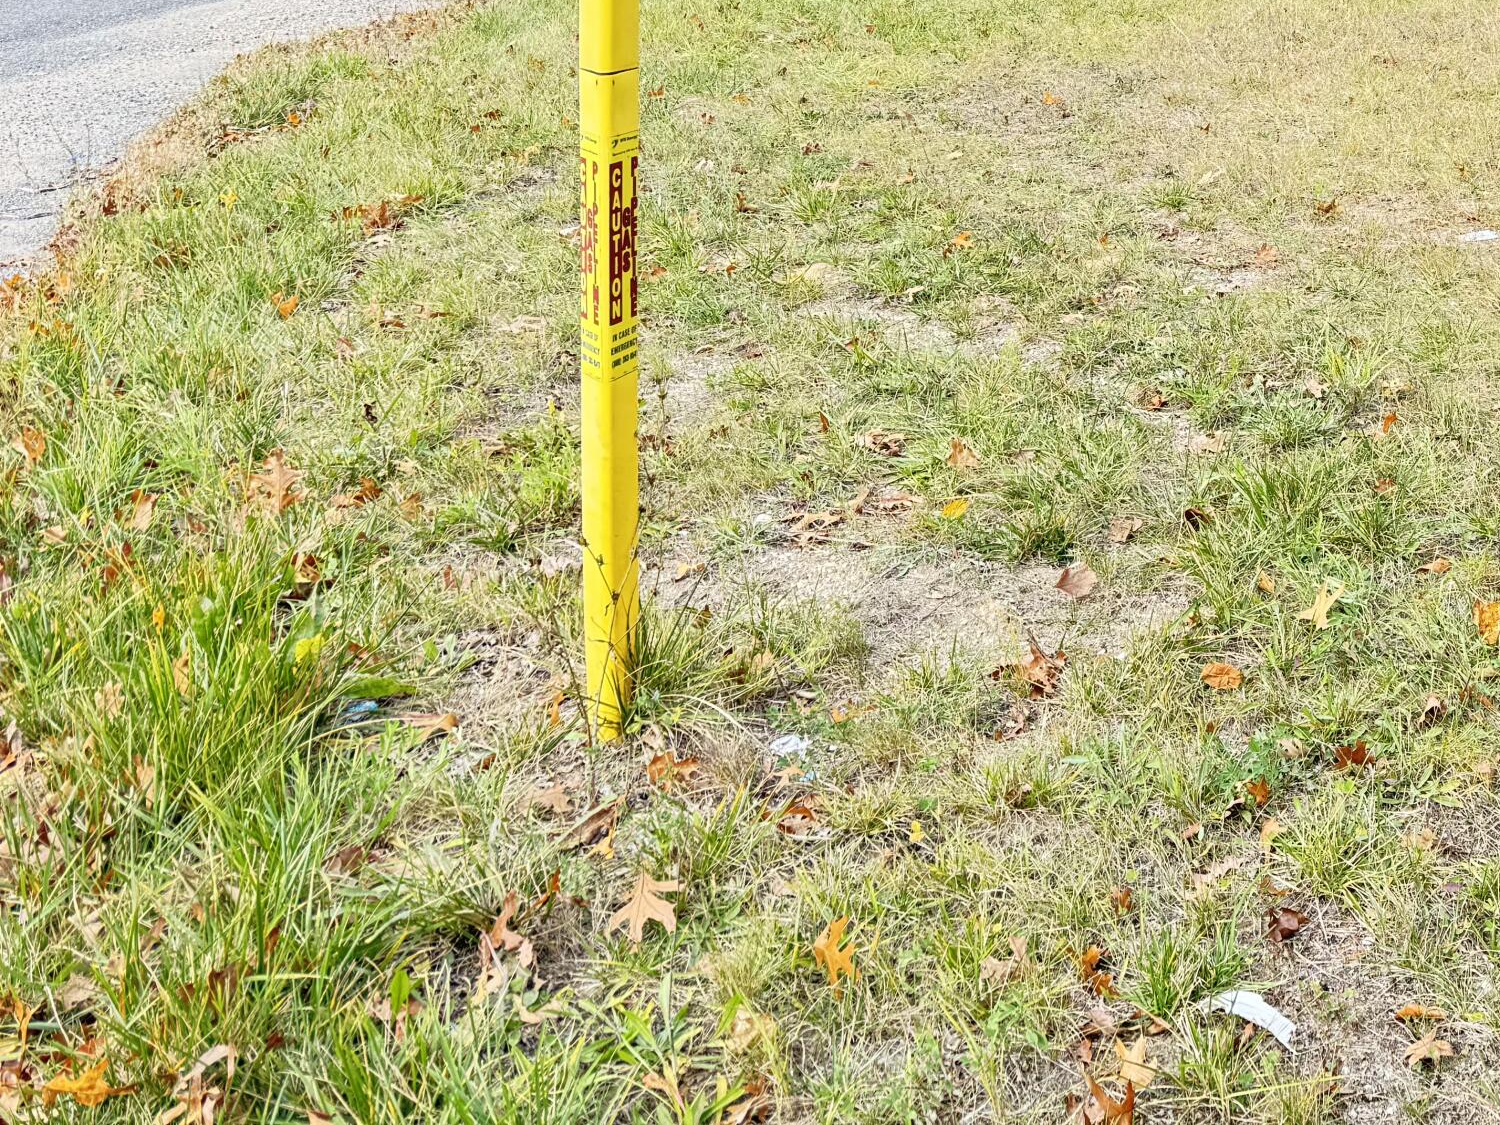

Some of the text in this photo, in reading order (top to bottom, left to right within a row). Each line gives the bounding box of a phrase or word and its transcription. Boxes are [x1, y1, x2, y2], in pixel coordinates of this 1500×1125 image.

[612, 168, 621, 320] CAUTION
[622, 207, 631, 273] GAS
[611, 337, 638, 356] EMERGENCY
[612, 333, 618, 342] IN
[618, 328, 630, 339] CASE
